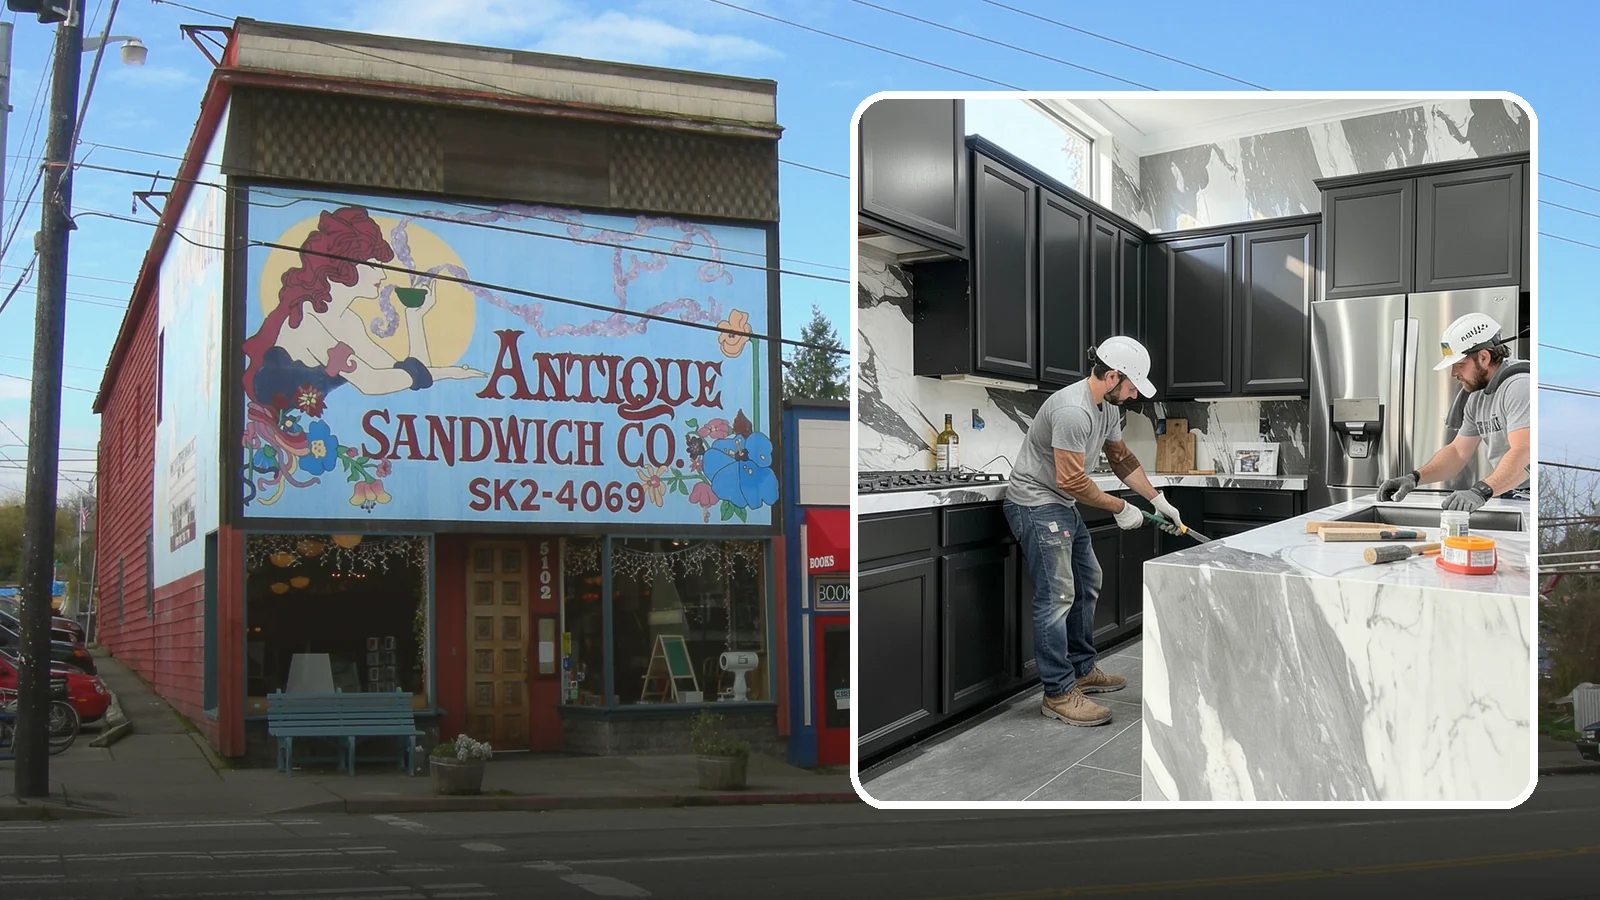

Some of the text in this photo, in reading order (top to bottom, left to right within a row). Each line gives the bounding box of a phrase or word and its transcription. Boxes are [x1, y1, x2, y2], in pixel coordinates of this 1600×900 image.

[476, 329, 723, 421] ANTIQUE
[361, 408, 685, 469] SANDWICH CO.
[468, 477, 645, 513] SK2-4069
[540, 541, 552, 600] 5102
[809, 555, 834, 569] BOOKS
